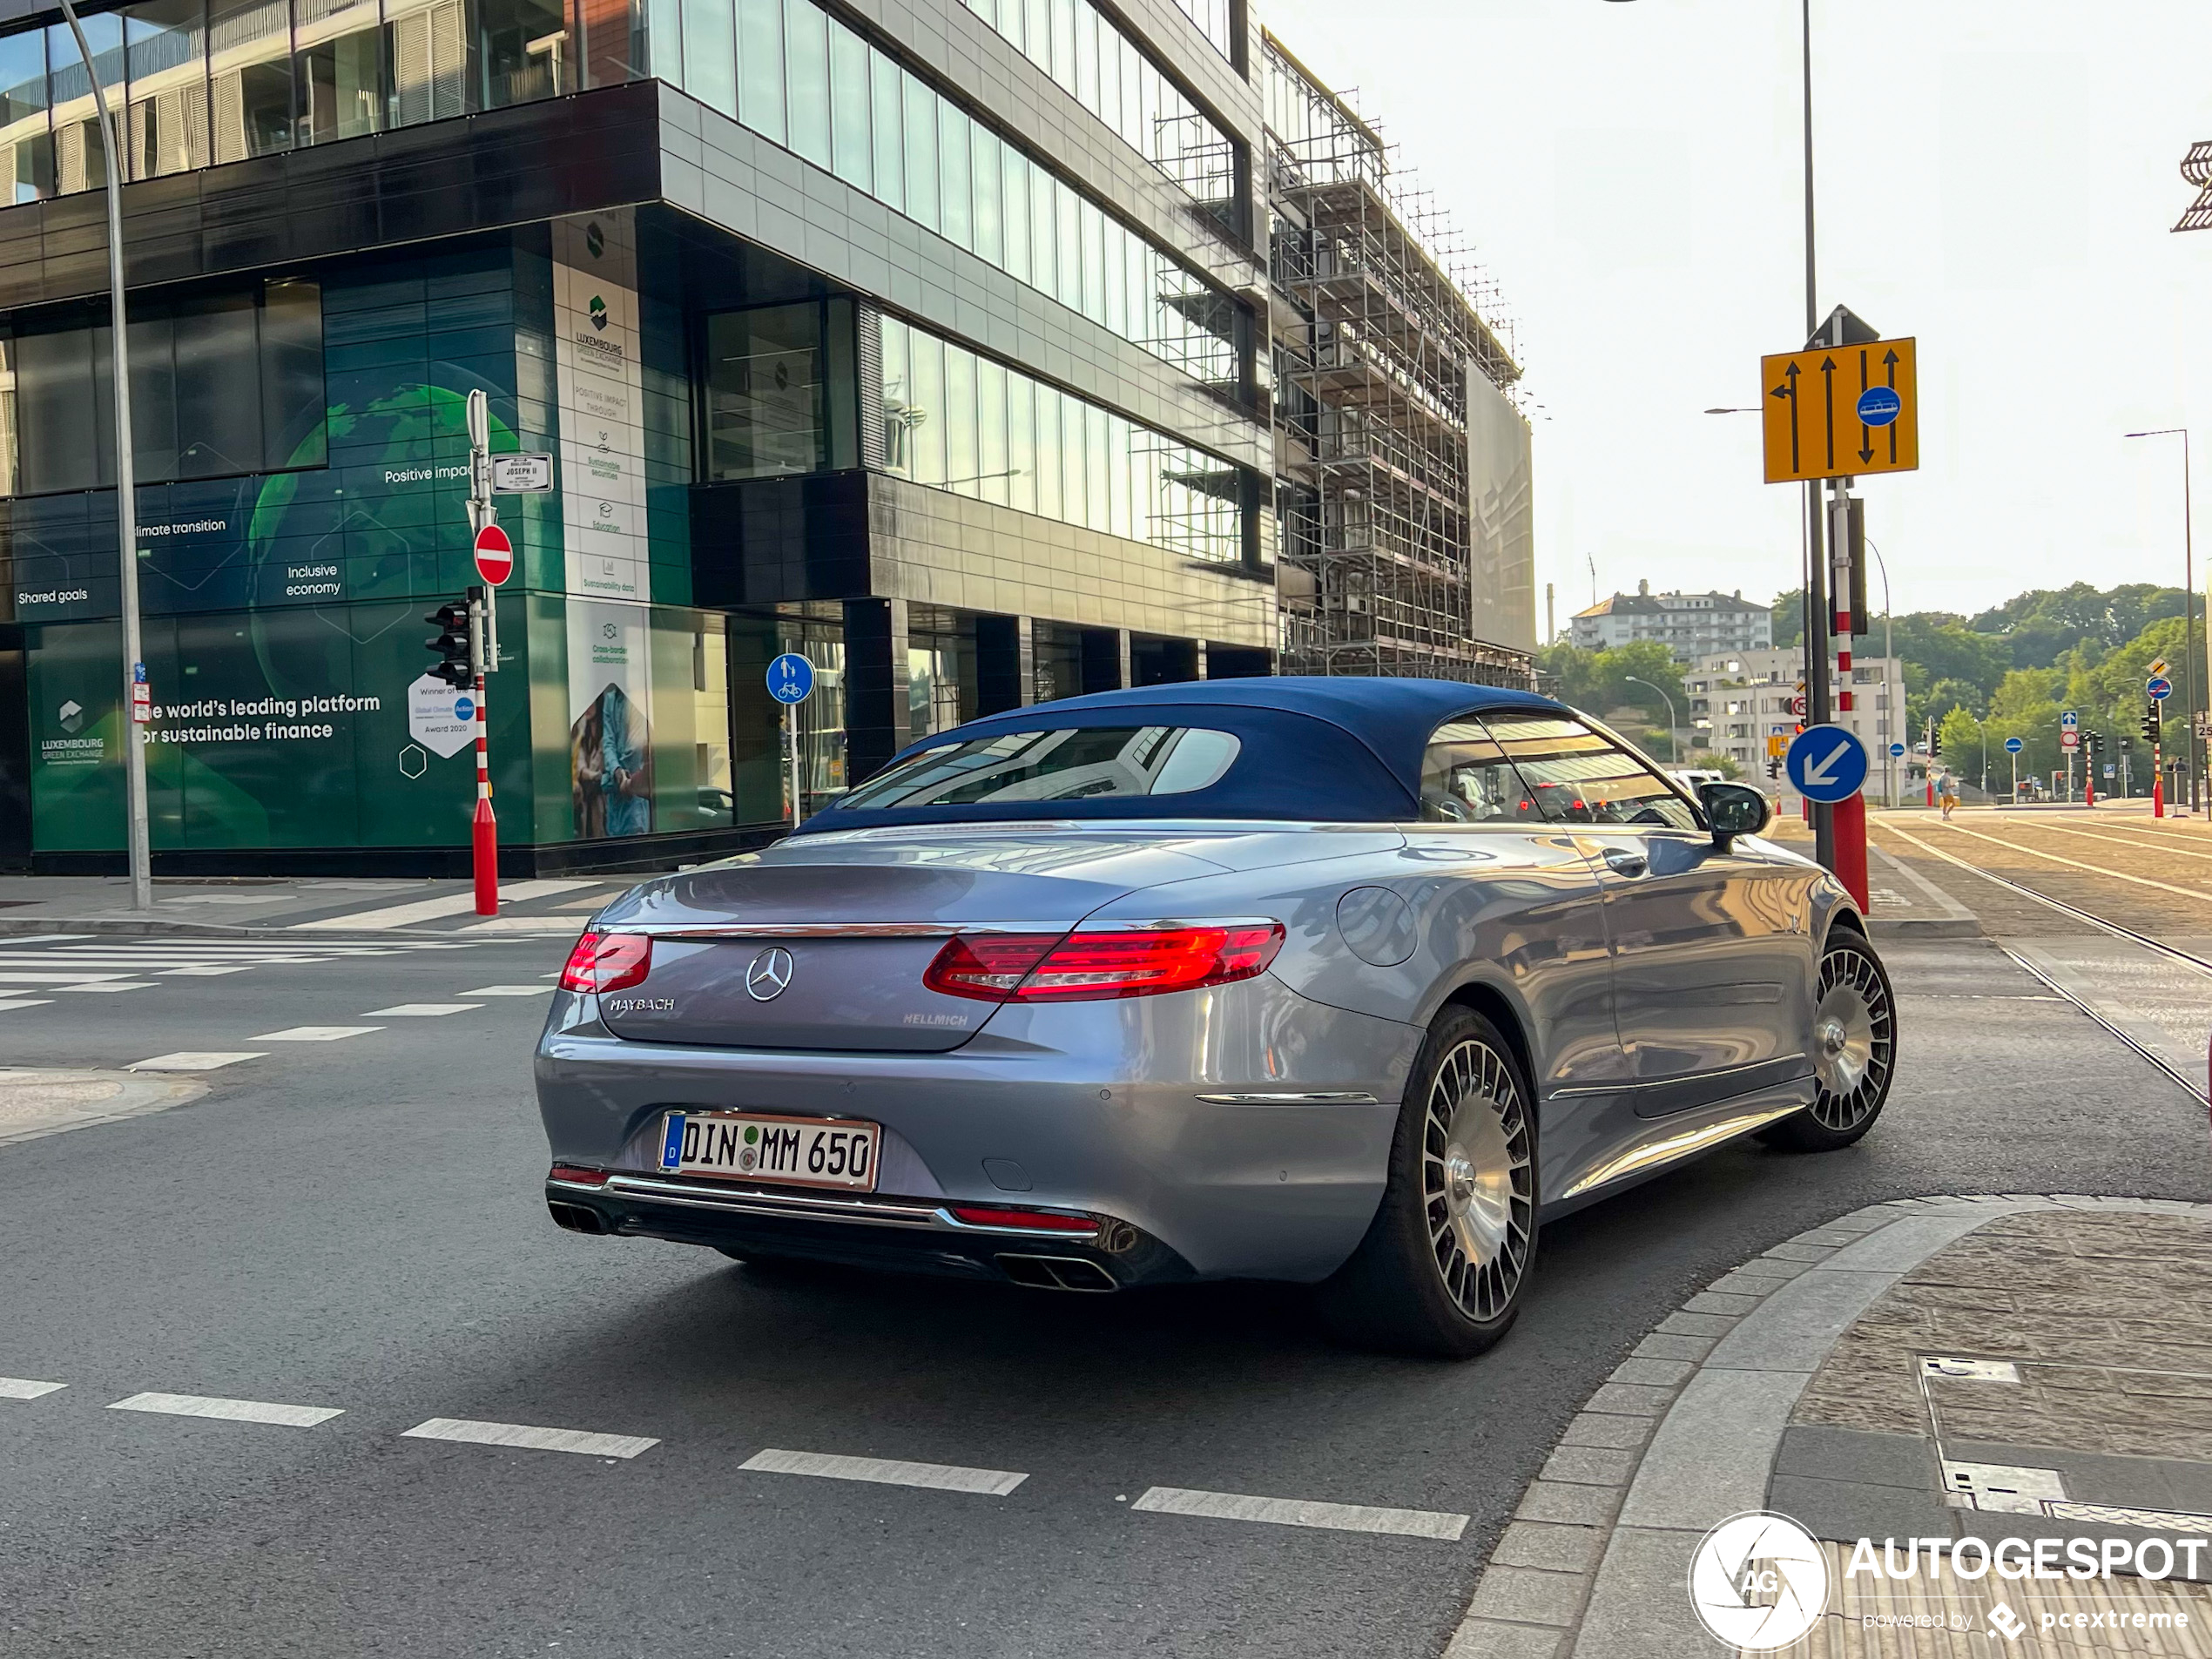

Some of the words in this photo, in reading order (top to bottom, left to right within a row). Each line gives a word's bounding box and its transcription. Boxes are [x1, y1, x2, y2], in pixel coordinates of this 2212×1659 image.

[576, 332, 622, 355] LUXEMBOURG
[577, 345, 594, 357] GREEN
[595, 351, 623, 367] EXCHANGE
[575, 386, 603, 402] POSITIVE
[604, 395, 627, 408] IMPACT
[586, 402, 617, 417] THROUGH
[385, 468, 433, 483] Positive
[435, 465, 472, 480] impac
[135, 525, 171, 537] limate
[172, 519, 226, 535] transition
[592, 521, 621, 533] Education
[287, 563, 338, 579] Inclusive
[286, 582, 341, 597] economy
[583, 579, 621, 593] Sustainability
[622, 583, 635, 593] data
[18, 590, 57, 604] Shared
[57, 588, 88, 604] goals
[231, 697, 297, 718] leading
[301, 693, 381, 718] platform
[144, 730, 158, 744] or
[160, 723, 261, 744] sustainable
[264, 722, 334, 740] finance
[425, 724, 448, 733] Award
[41, 738, 104, 751] LUXEMBOURG
[42, 751, 65, 759] GREEN
[65, 749, 104, 759] EXCHANGE
[610, 998, 676, 1011] MAYBACH
[903, 1013, 968, 1027] HELLMICH
[668, 1146, 676, 1159] D
[681, 1122, 739, 1167] DIN
[759, 1127, 802, 1172] MM
[807, 1131, 870, 1178] 650
